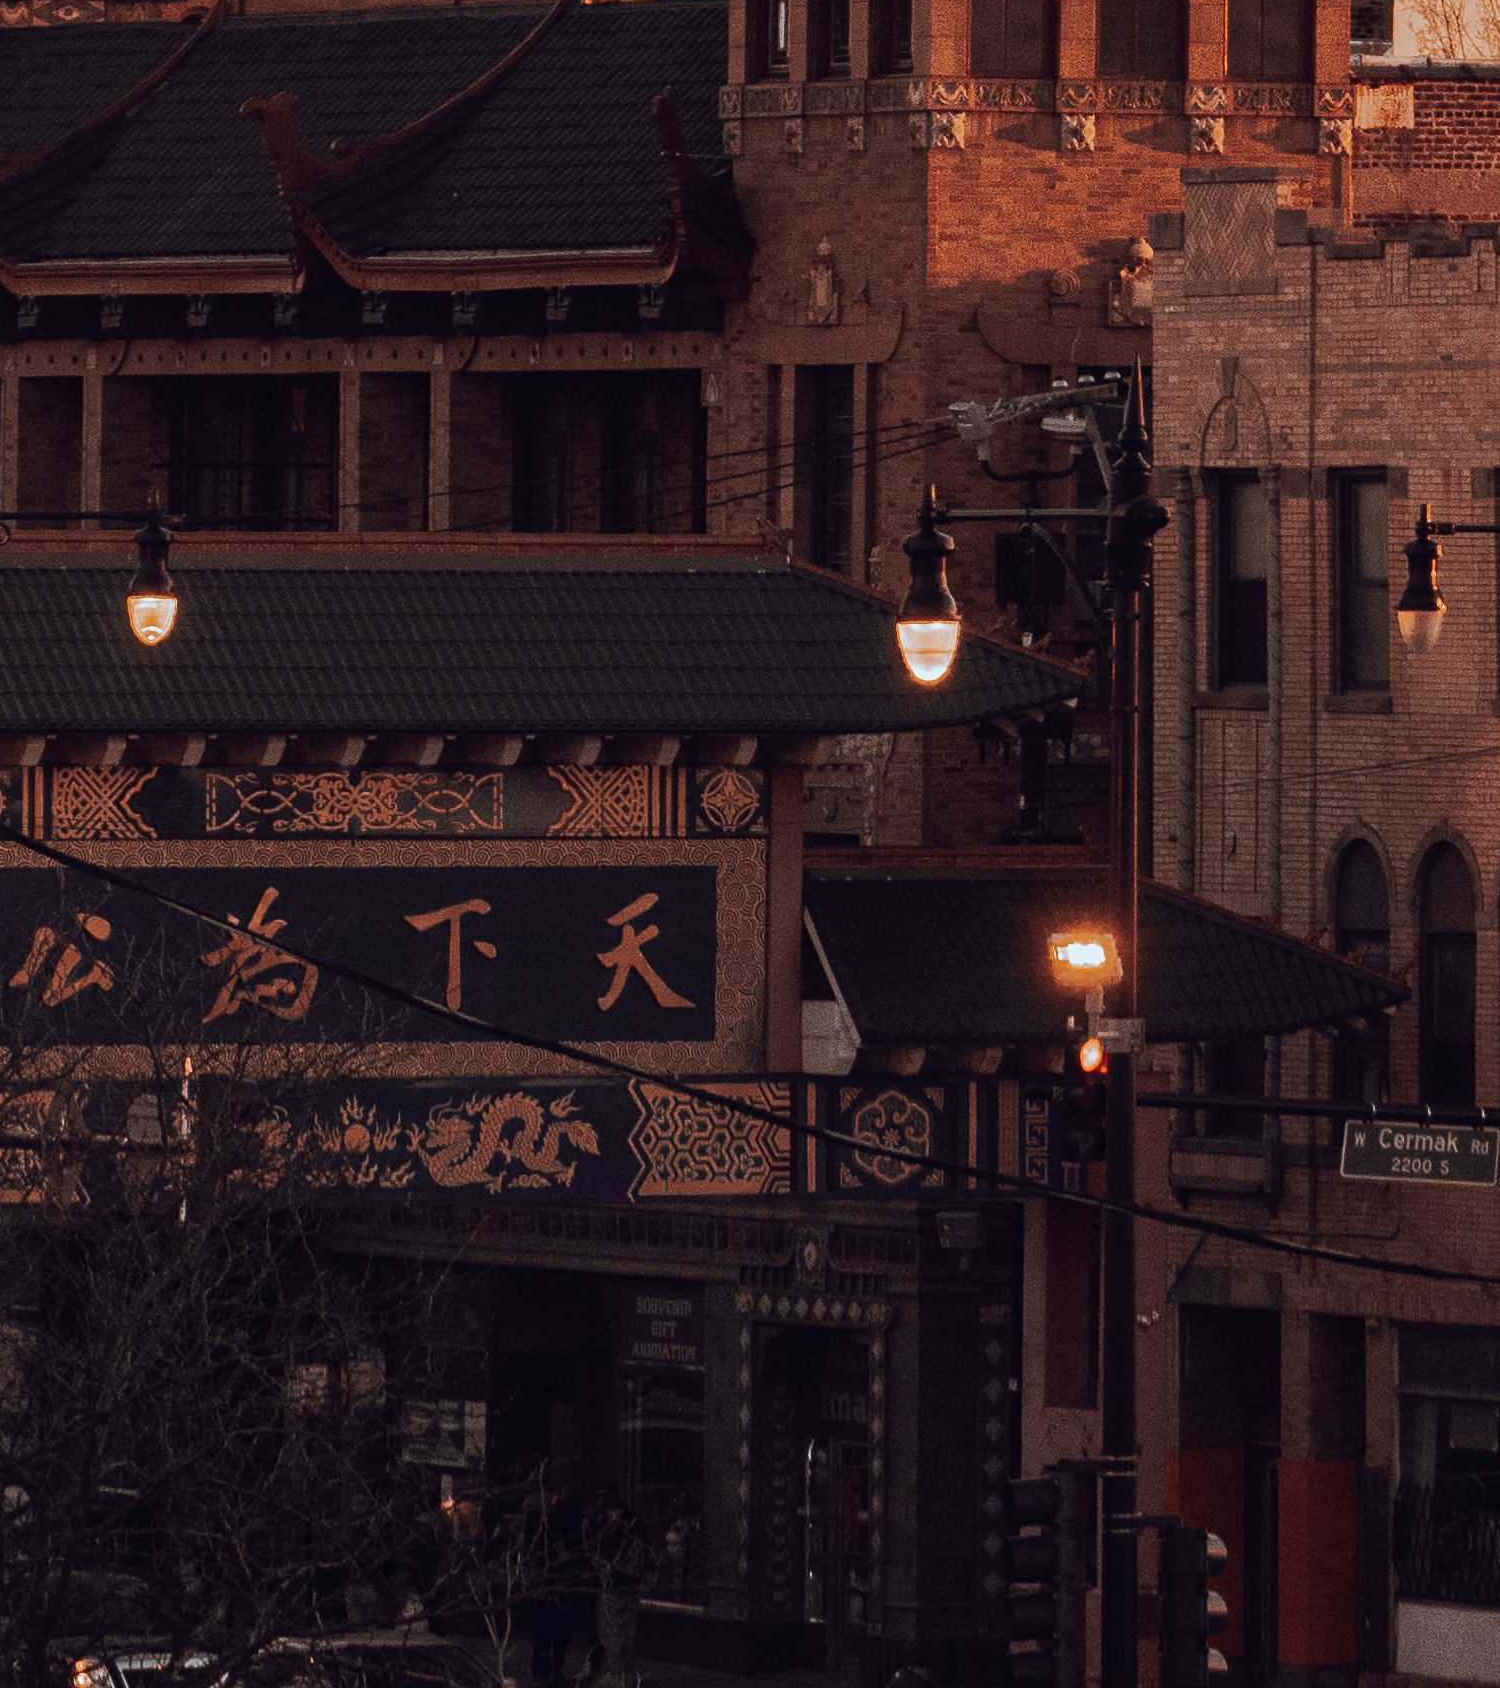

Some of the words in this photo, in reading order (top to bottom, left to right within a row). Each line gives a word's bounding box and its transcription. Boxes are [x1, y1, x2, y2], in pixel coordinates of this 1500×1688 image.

[1354, 1131, 1367, 1148] W
[1378, 1126, 1459, 1154] Cermak
[1470, 1138, 1490, 1156] Rd
[1390, 1157, 1433, 1175] 2200
[1439, 1160, 1450, 1176] S
